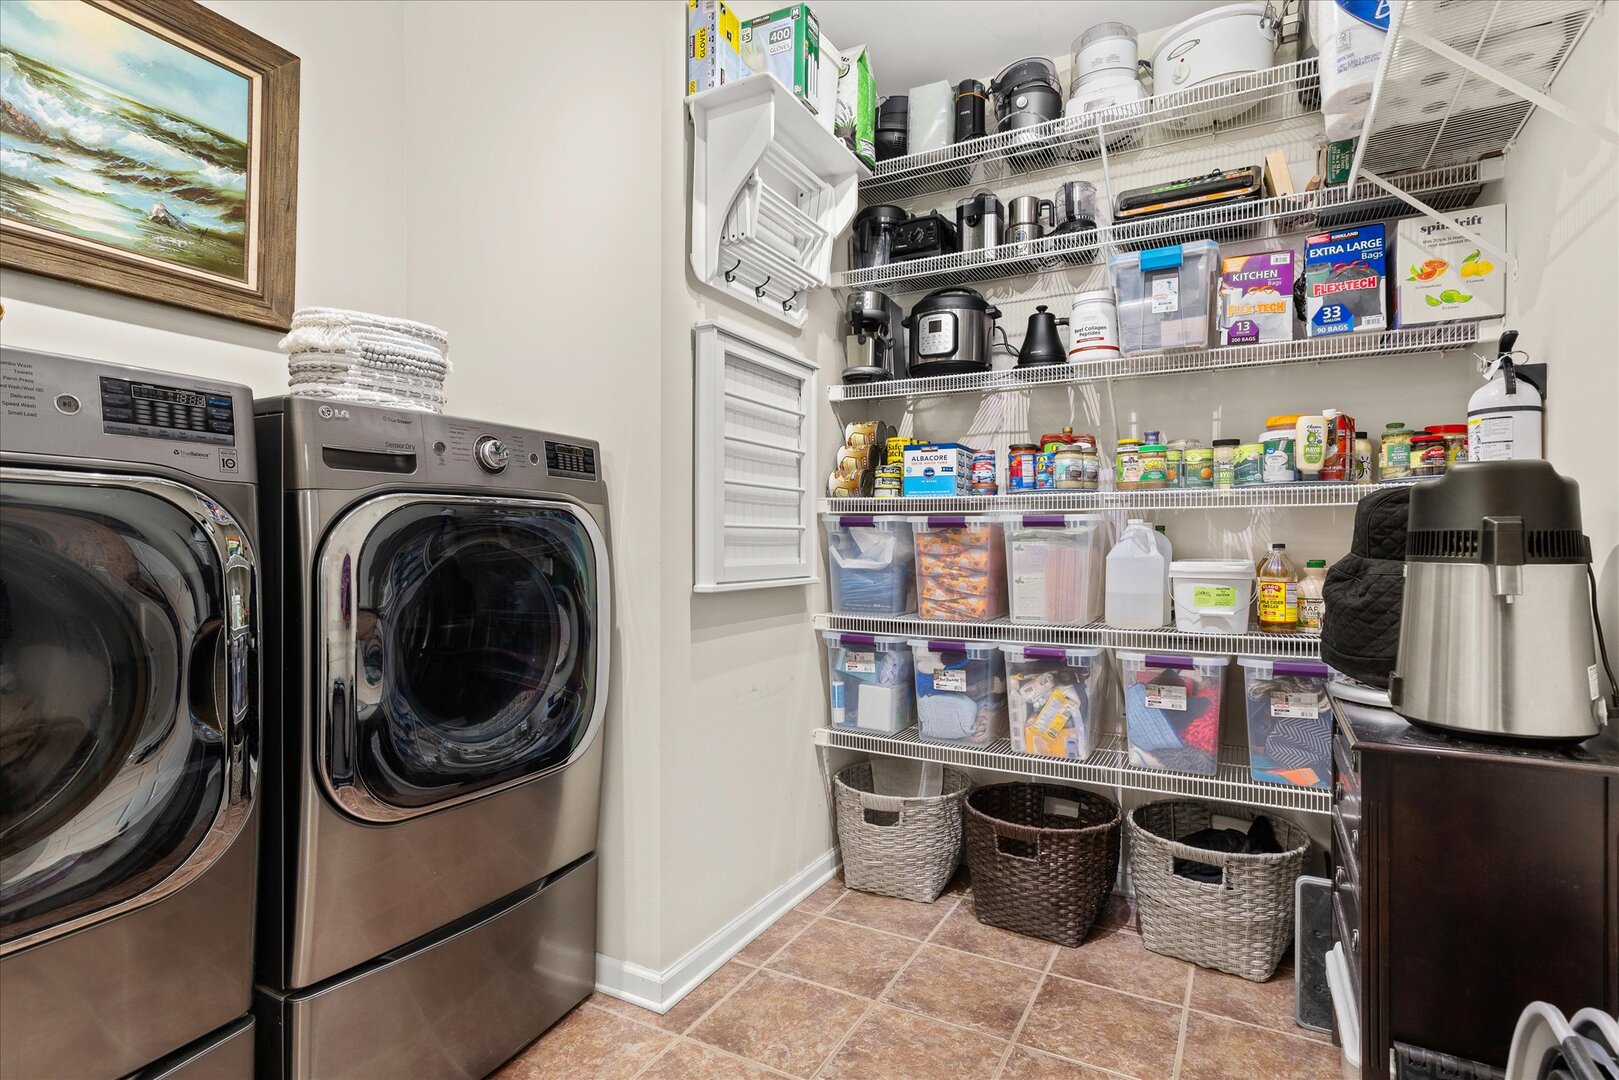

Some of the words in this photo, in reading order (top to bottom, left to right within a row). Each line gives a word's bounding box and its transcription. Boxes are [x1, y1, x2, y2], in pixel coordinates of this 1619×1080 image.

[770, 28, 790, 42] 400
[769, 42, 790, 54] GLOVES
[1309, 244, 1345, 258] EXTRA
[1346, 237, 1383, 252] LARGE
[1361, 250, 1383, 260] Bags
[1232, 269, 1278, 283] KITCHEN
[1322, 306, 1342, 319] 33
[1236, 321, 1251, 332] 13
[1327, 324, 1349, 333] BAGS
[10, 392, 36, 400] Delicates
[335, 409, 350, 418] LG
[385, 441, 405, 450] Sensor
[405, 443, 416, 451] Dry
[888, 442, 902, 451] Safe
[887, 450, 904, 458] atch
[911, 454, 948, 462] ALBACORE
[221, 458, 236, 469] 10
